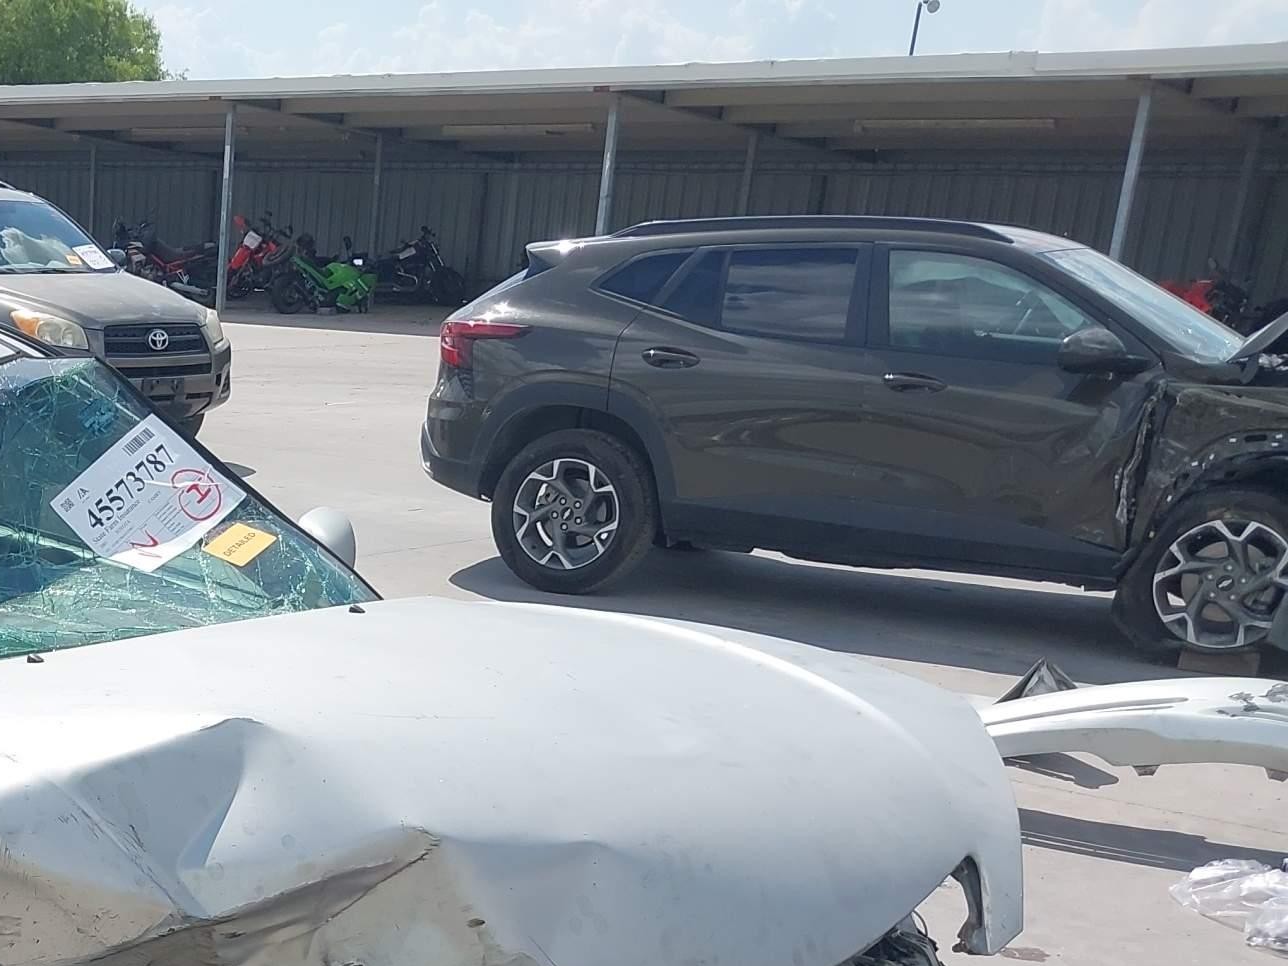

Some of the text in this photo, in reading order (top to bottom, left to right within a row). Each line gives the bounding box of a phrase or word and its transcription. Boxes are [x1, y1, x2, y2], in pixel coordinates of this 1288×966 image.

[87, 443, 174, 528] 45573787
[103, 518, 119, 532] Farm
[116, 498, 141, 520] Insurance
[223, 531, 256, 557] DETAILED
